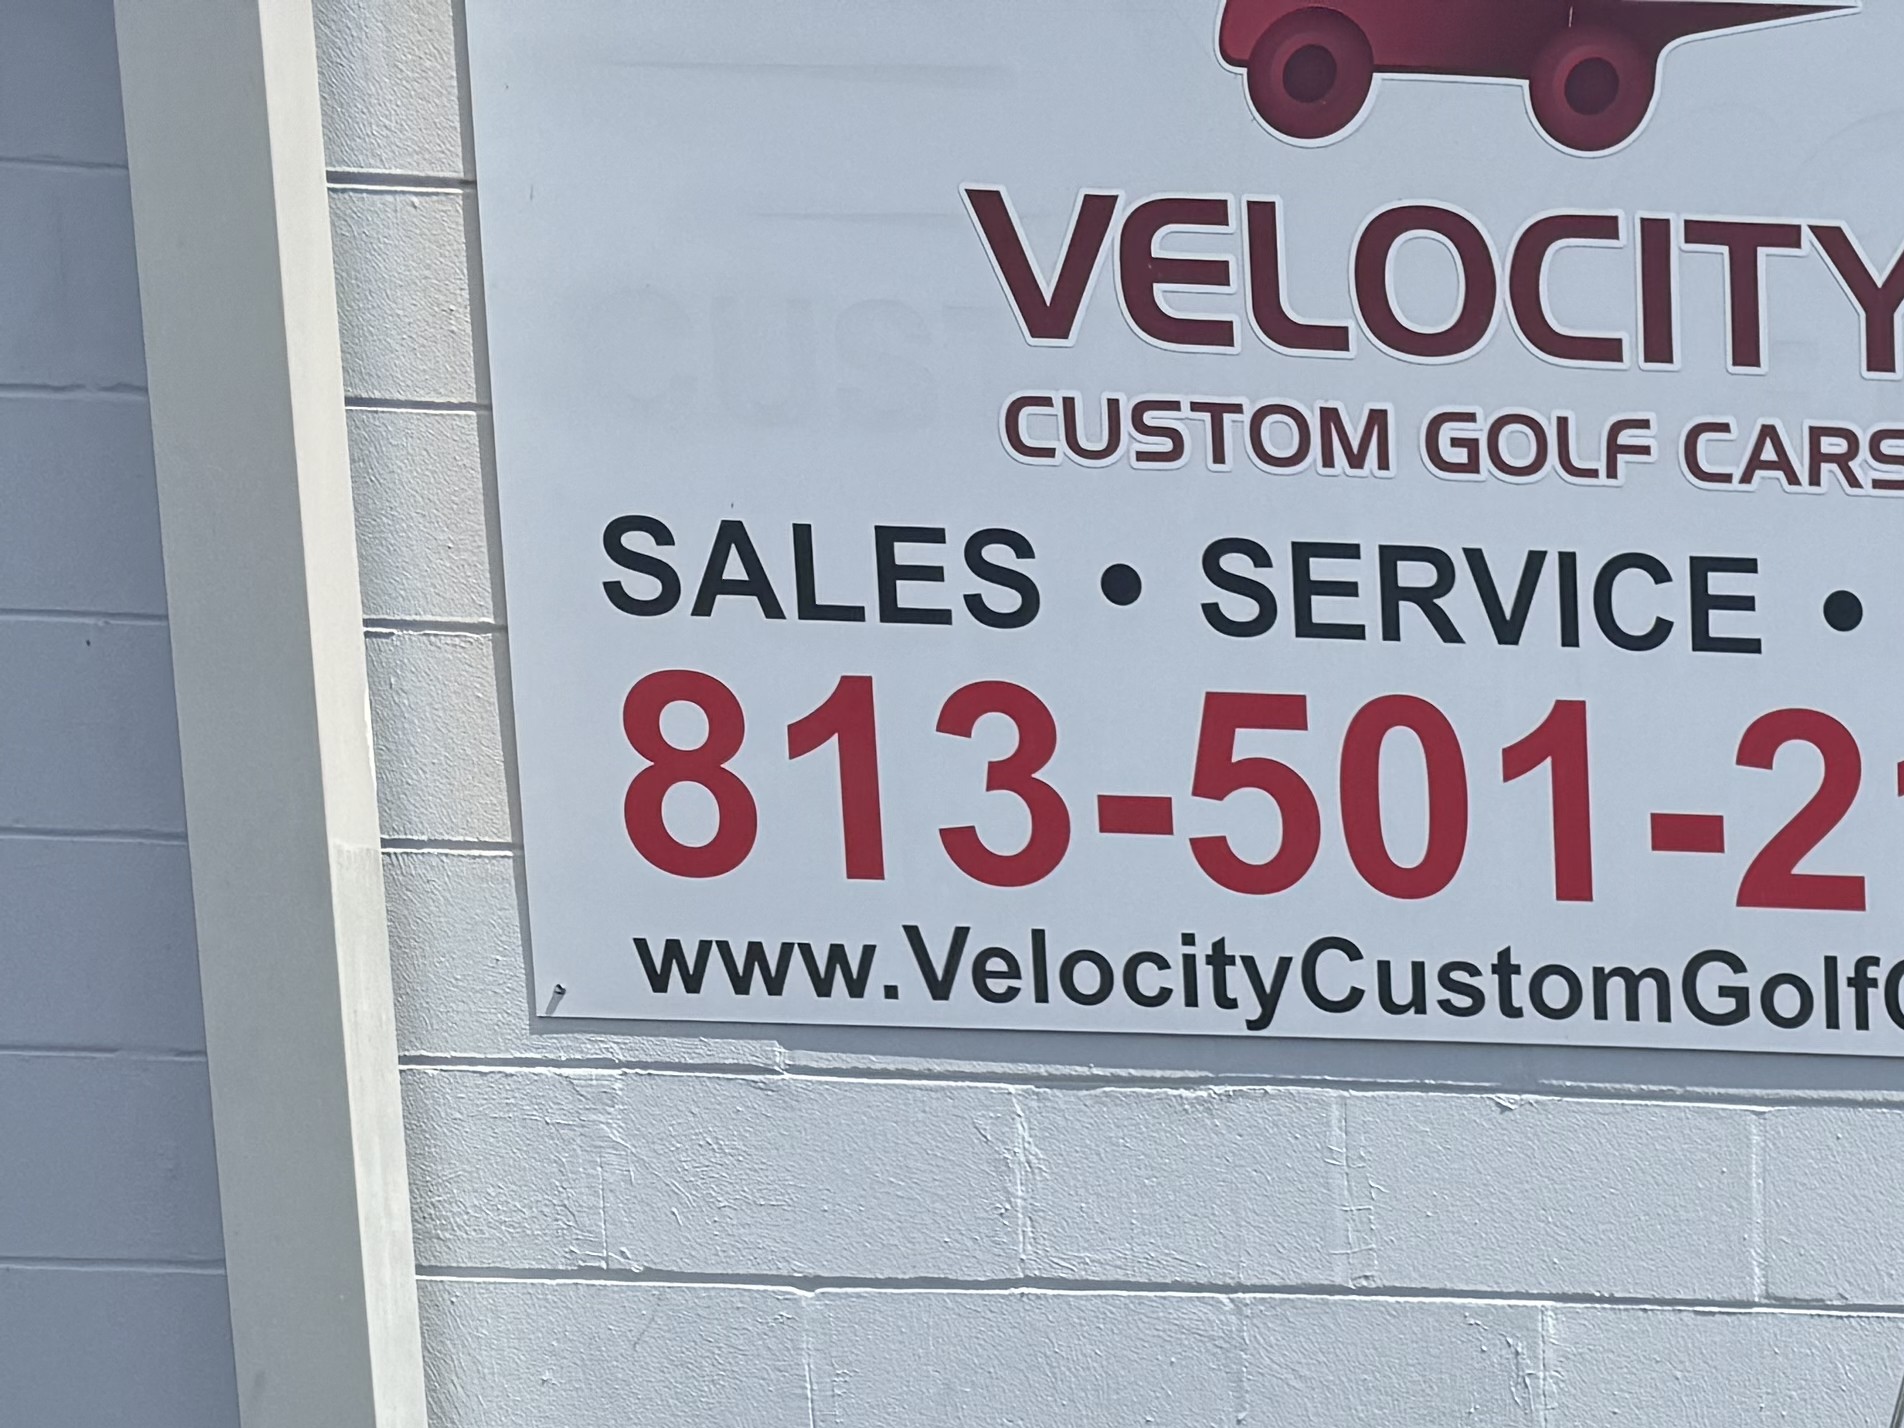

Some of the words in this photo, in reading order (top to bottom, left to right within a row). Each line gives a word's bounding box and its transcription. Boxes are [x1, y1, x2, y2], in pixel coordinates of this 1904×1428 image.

[1003, 394, 1391, 471] CUSTOM
[1425, 410, 1653, 481] GOLF
[602, 514, 1041, 630] SALES
[1200, 537, 1762, 655] SERVICE
